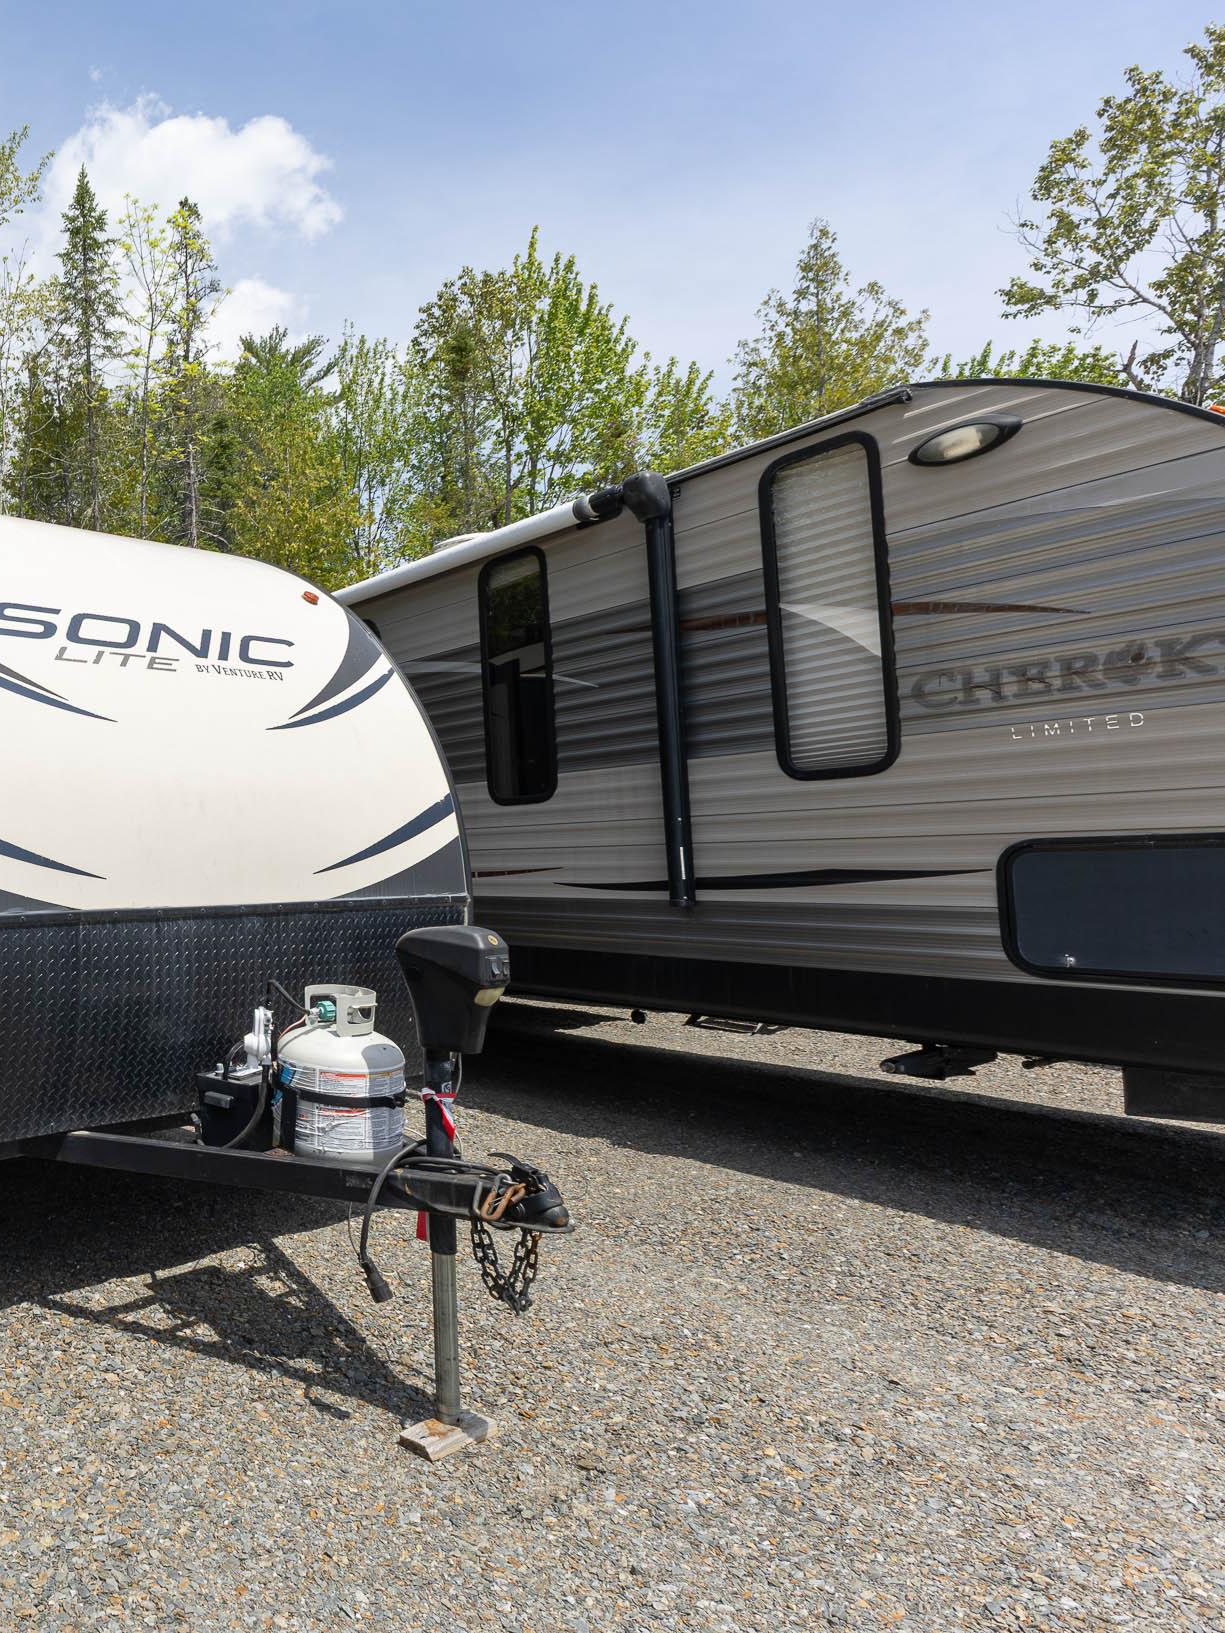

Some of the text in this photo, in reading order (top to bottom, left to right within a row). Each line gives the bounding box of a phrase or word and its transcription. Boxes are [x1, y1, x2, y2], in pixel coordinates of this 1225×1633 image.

[54, 646, 180, 672] LITE
[195, 664, 284, 681] BY VENTURE RV
[1011, 712, 1145, 740] LIMITED
